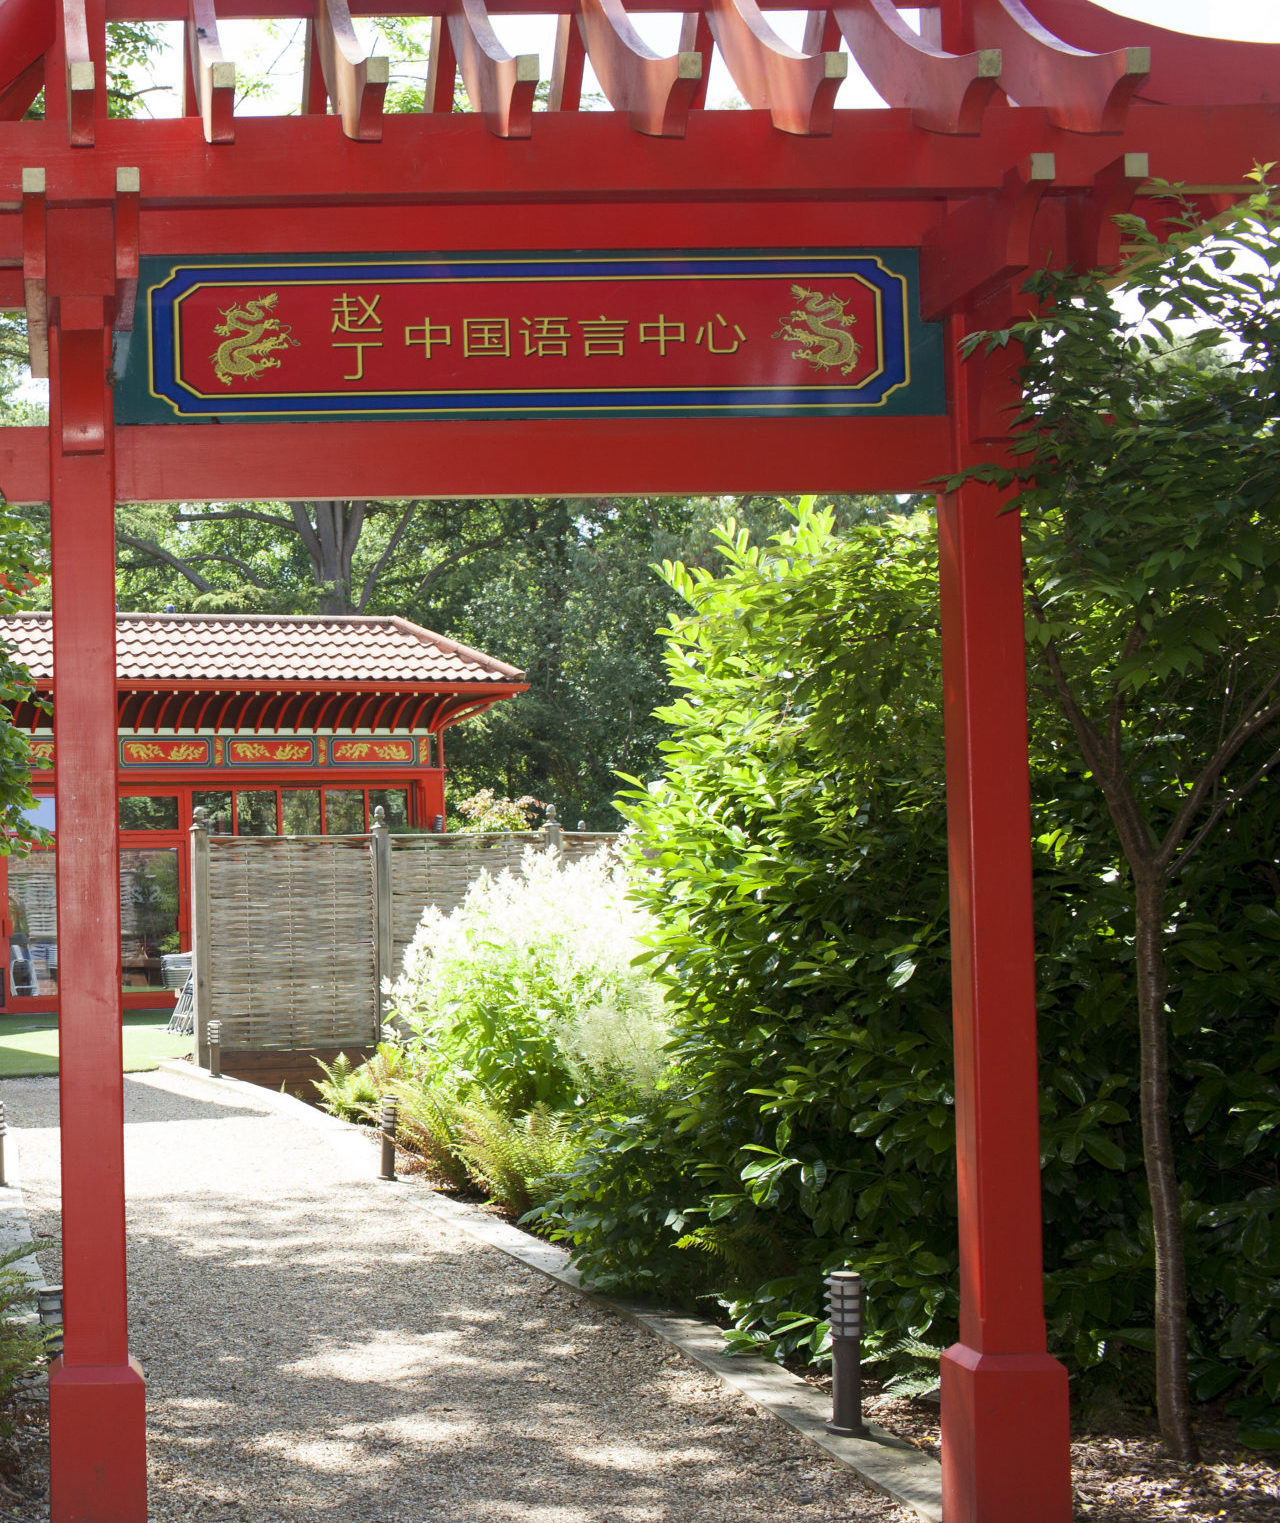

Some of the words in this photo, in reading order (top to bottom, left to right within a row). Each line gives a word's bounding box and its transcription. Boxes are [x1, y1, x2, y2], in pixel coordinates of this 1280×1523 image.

[404, 313, 747, 359] 中国语言中心
